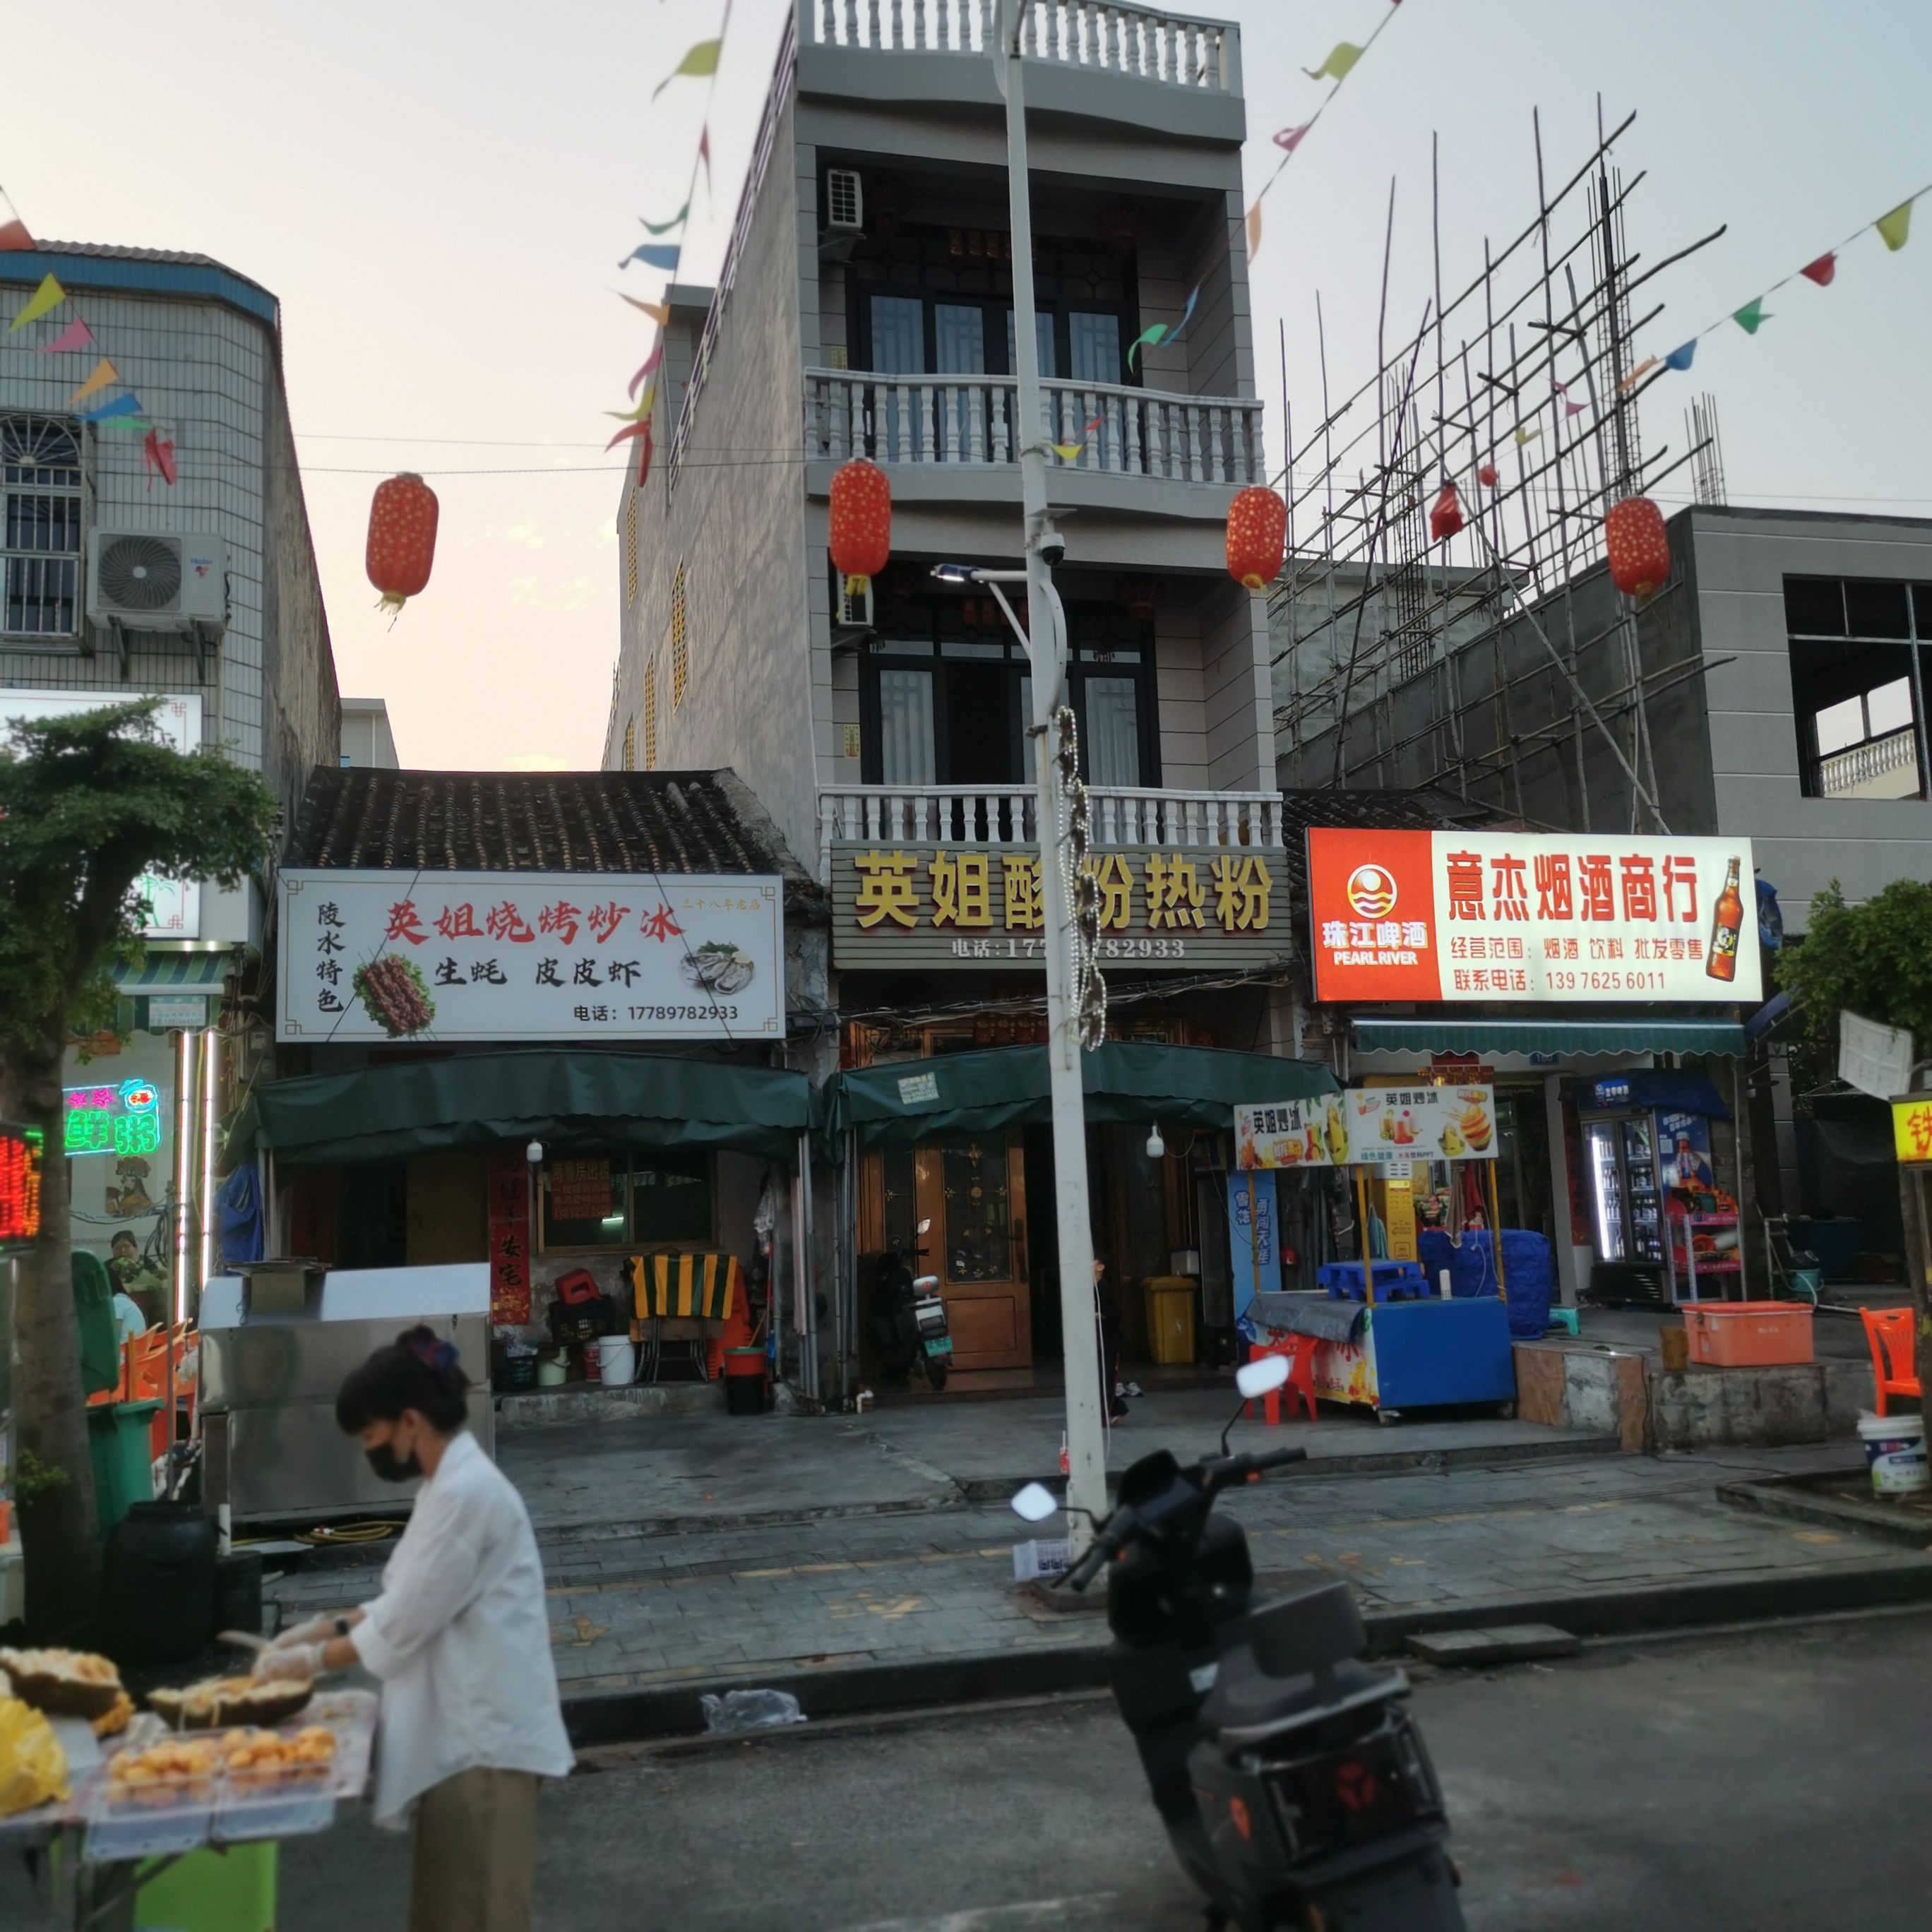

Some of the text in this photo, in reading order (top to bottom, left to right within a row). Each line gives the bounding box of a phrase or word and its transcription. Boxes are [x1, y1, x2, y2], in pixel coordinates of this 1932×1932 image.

[1447, 850, 1698, 922] 意杰烟酒商行
[681, 898, 761, 912] 三十八年老店
[383, 900, 686, 946] 英姐烧烤炒冰
[1322, 921, 1429, 949] 珠江啤酒
[316, 902, 345, 1013] 陵水特色
[1334, 951, 1419, 965] PEARL RIVER
[434, 957, 641, 988] 生蚝 皮皮虾
[1386, 1092, 1438, 1106] 英姐炒冰
[1253, 1107, 1302, 1135] 英姐炒冰
